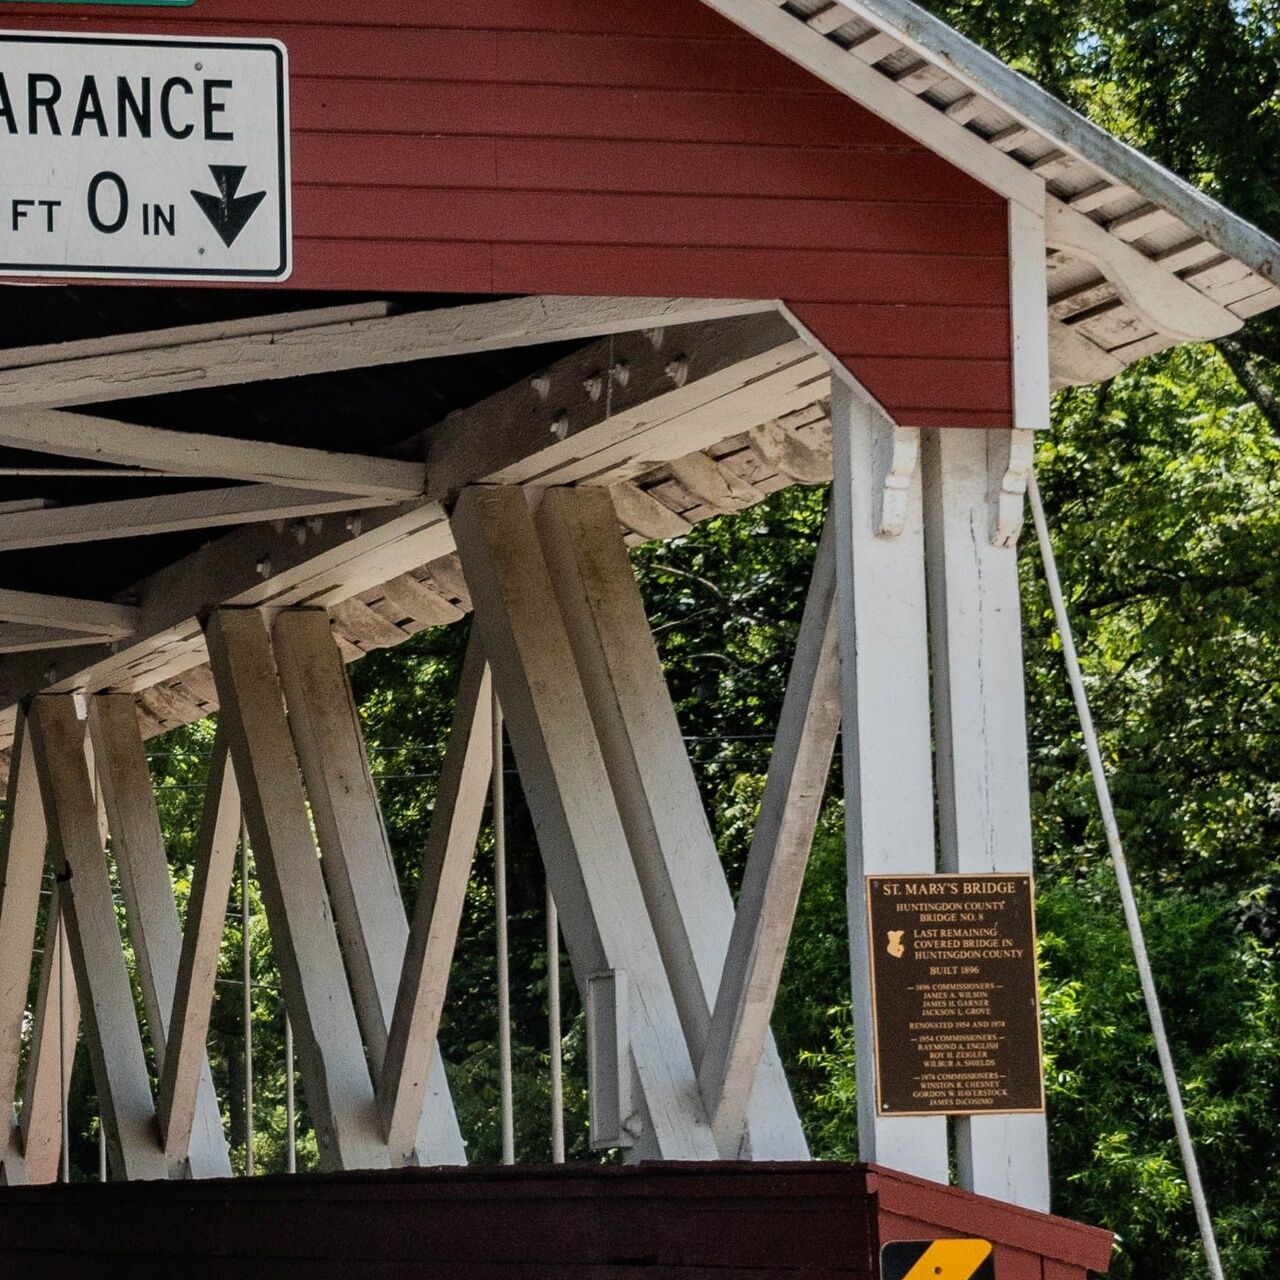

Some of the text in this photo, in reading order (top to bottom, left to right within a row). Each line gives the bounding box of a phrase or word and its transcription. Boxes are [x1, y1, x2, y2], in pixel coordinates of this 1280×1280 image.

[142, 204, 176, 237] IN
[883, 884, 901, 895] ST.
[963, 882, 1016, 894] BRIDGE
[896, 901, 1005, 912] HUNTINGDON COUNTY
[920, 914, 957, 922] BRIDGE
[960, 913, 975, 921] NO.
[914, 928, 997, 938] LAST REMAINING
[914, 940, 960, 948] COVERED
[963, 939, 999, 948] BRIDGE
[914, 950, 1022, 959] HUNTINGDON COUNTY
[930, 966, 980, 975] BUILT 1896
[937, 1072, 998, 1080] COMMISSIONERS
